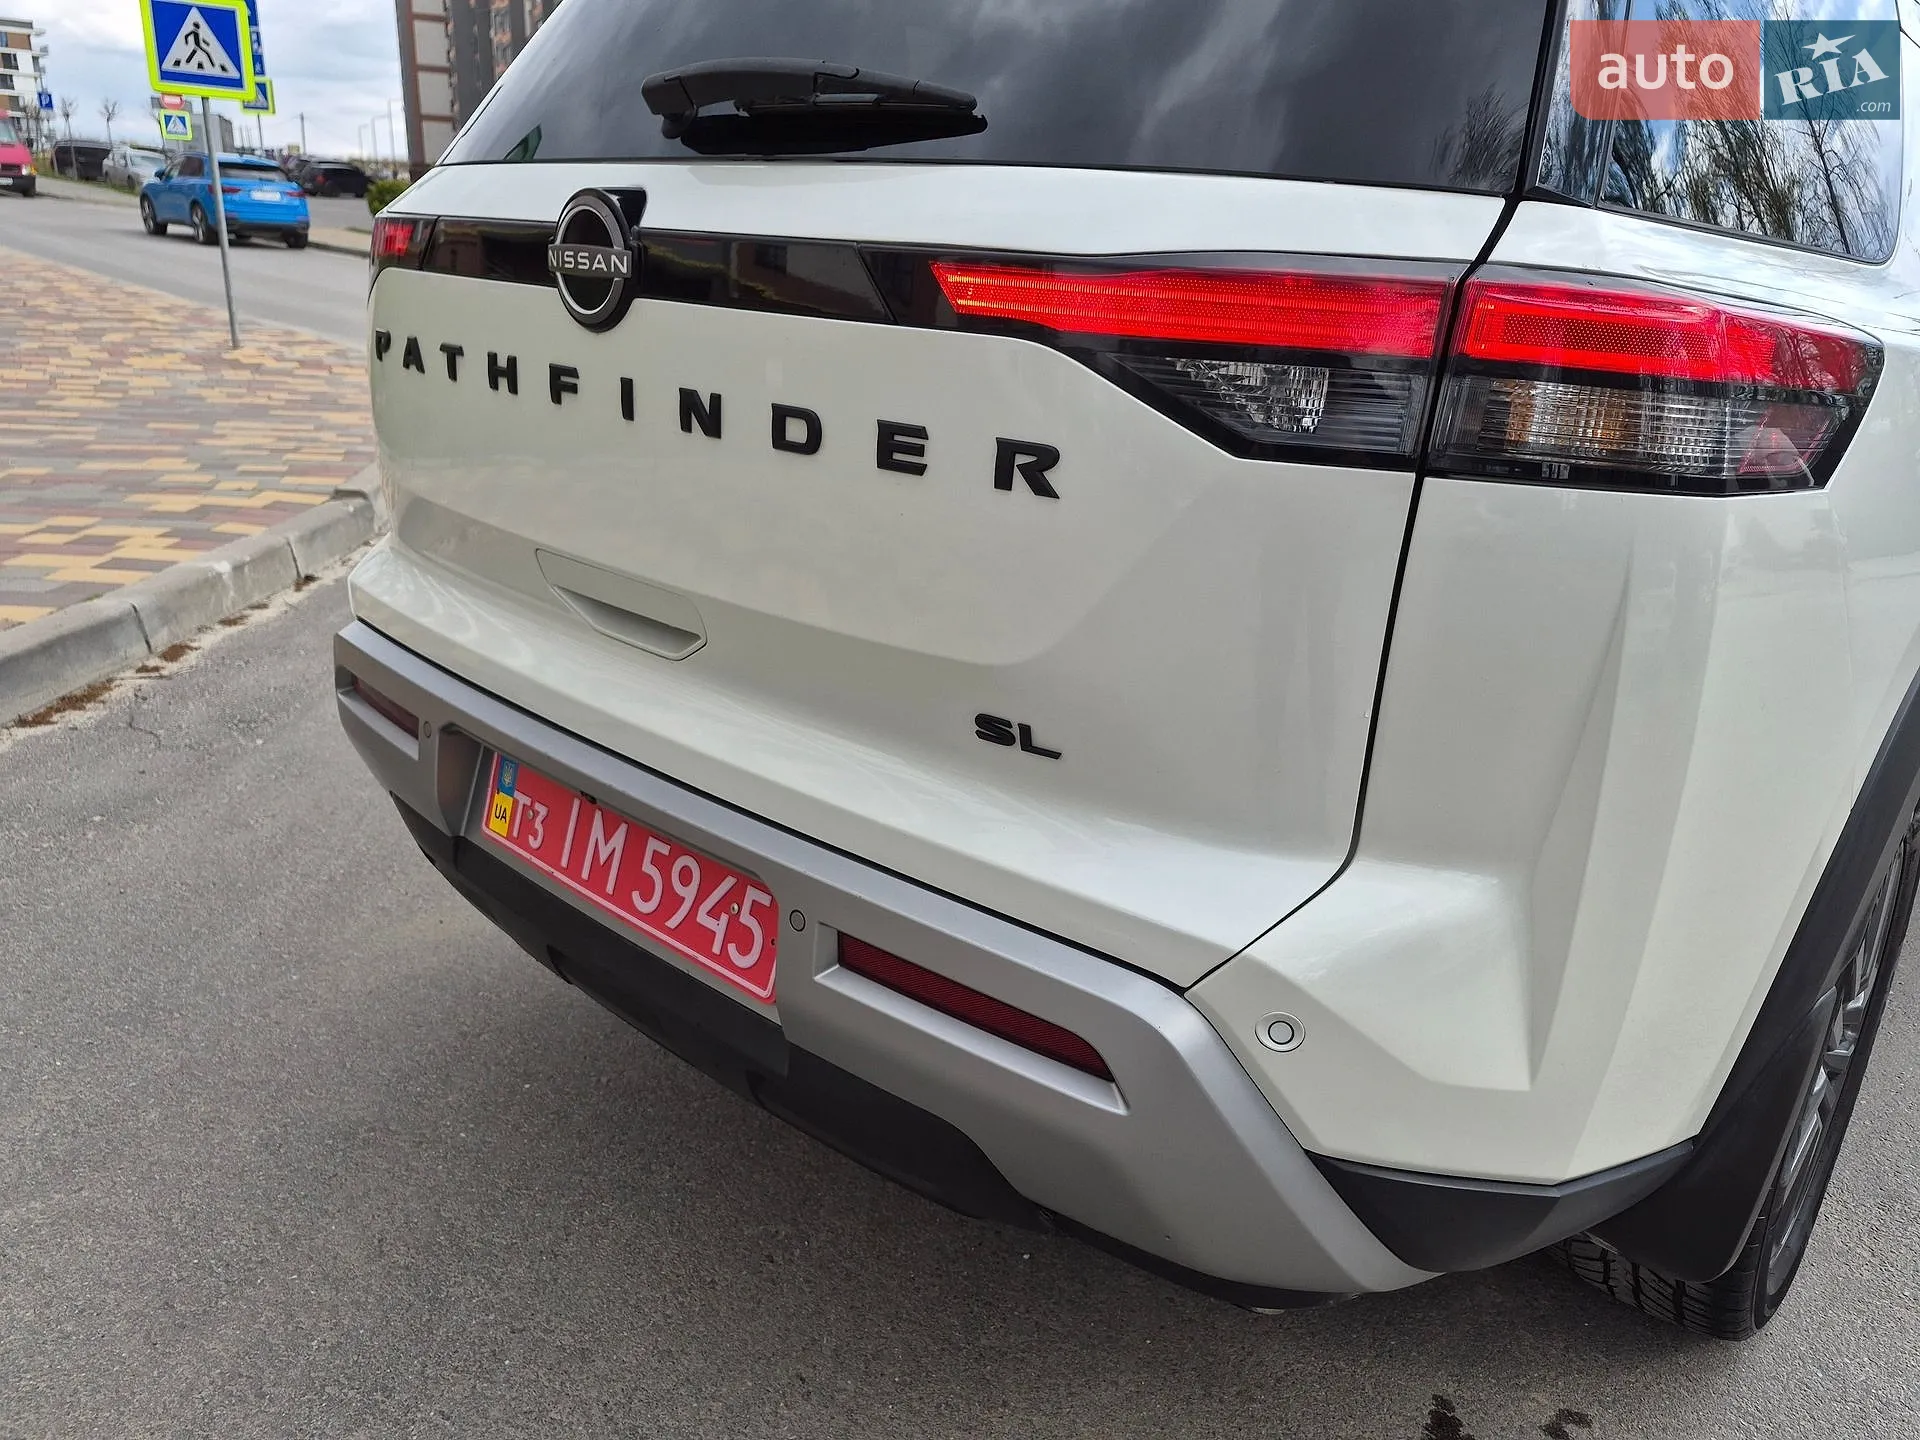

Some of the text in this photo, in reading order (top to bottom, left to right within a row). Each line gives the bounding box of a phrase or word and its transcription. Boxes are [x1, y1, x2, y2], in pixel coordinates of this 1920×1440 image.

[548, 249, 628, 274] NISSAN
[375, 328, 1060, 499] PATHFINDER
[975, 713, 1062, 760] SL
[494, 803, 507, 824] UA
